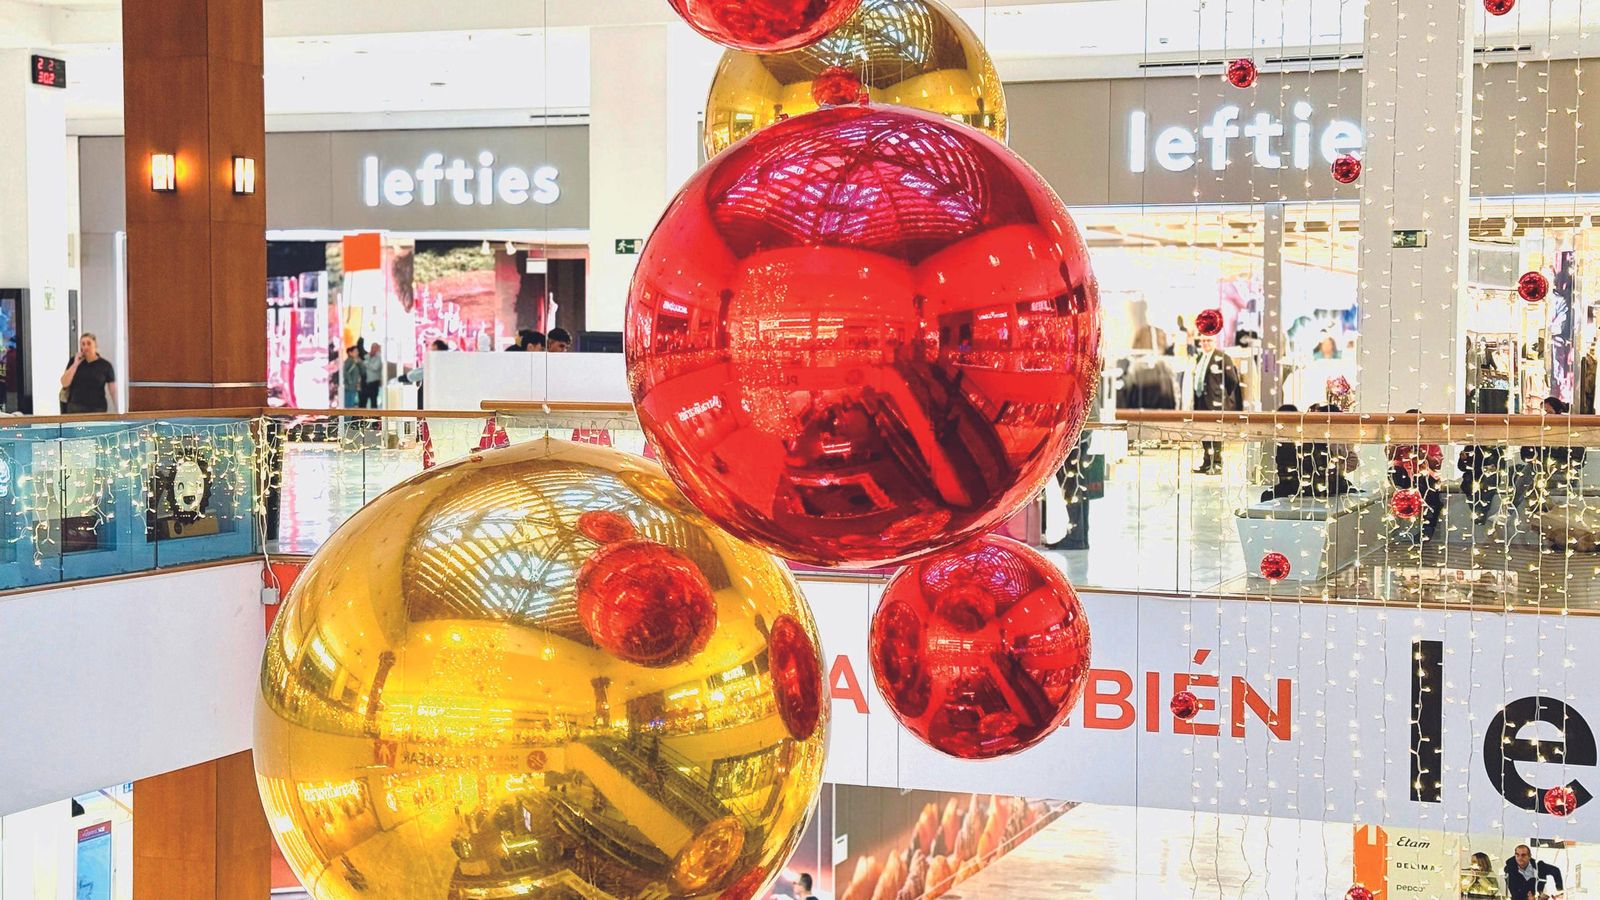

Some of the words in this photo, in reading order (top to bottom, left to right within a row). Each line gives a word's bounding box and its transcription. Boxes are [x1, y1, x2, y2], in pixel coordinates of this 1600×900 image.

[365, 151, 561, 207] lefties
[1396, 836, 1431, 848] Etam
[1396, 884, 1424, 892] pepco
